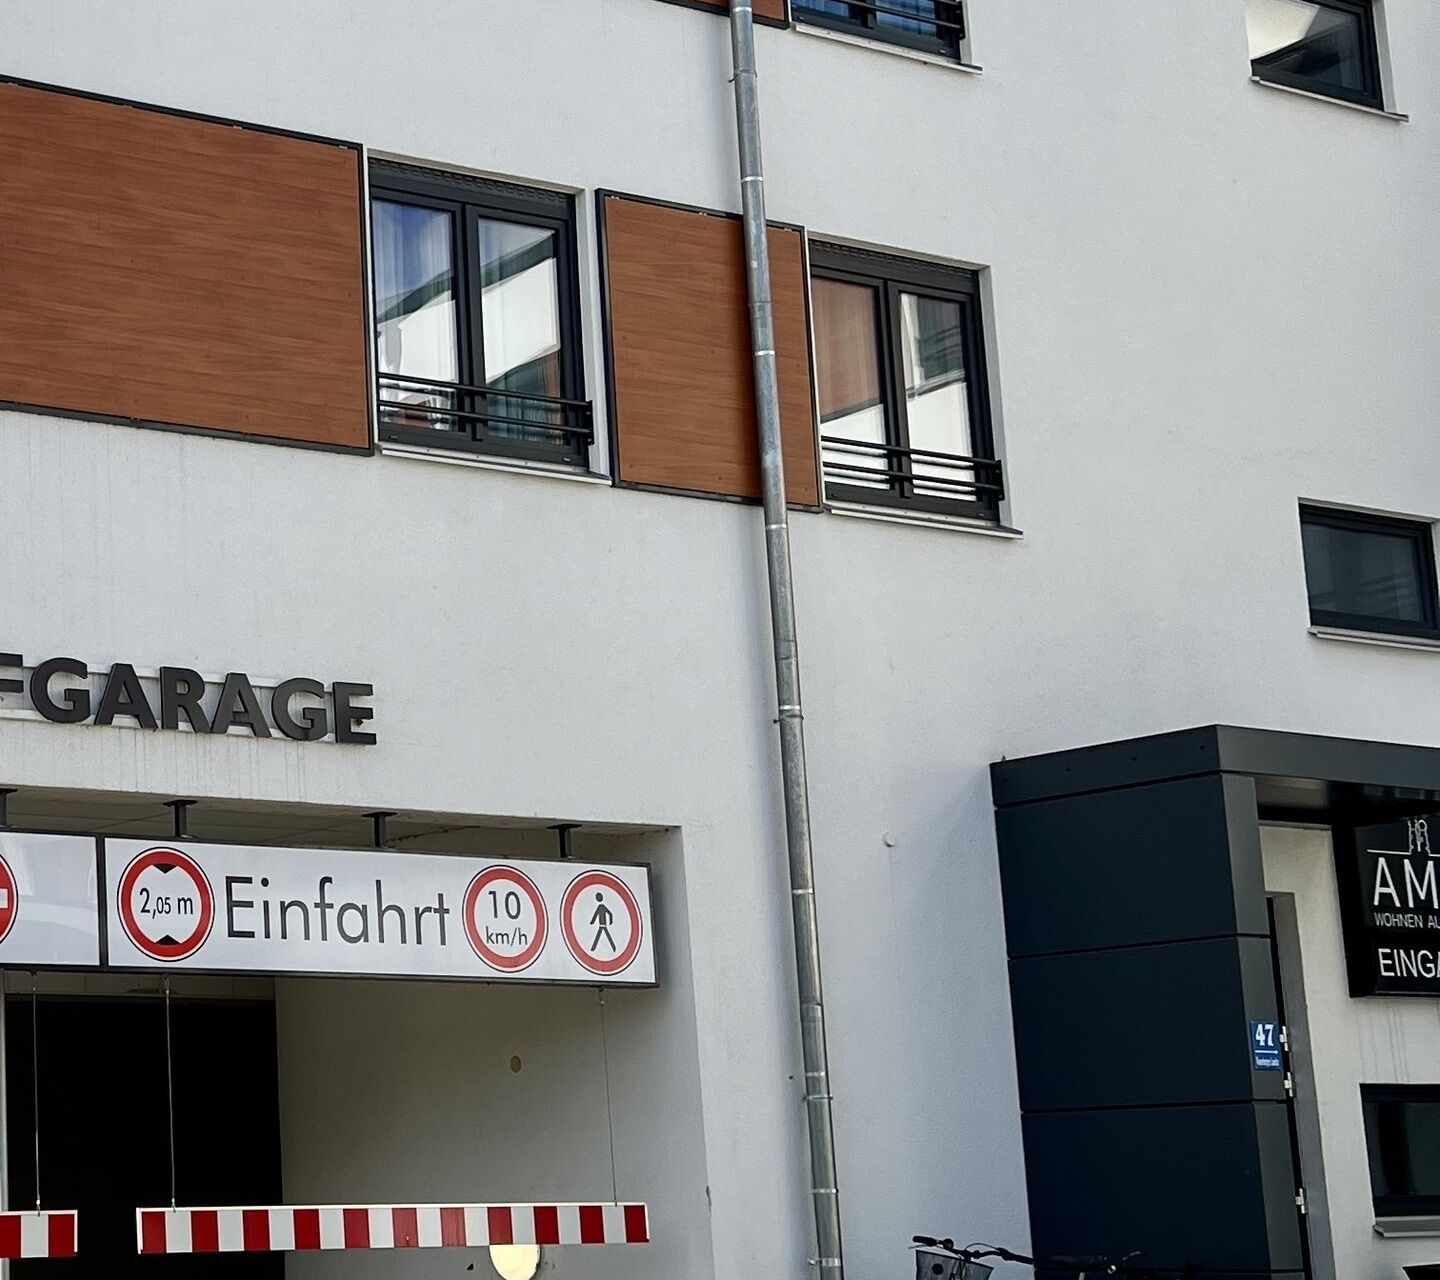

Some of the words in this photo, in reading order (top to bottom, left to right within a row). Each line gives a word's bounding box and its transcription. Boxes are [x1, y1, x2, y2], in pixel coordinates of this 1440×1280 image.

[177, 896, 194, 916] m
[224, 874, 450, 946] Einfahrt
[488, 890, 521, 920] 10
[1374, 912, 1423, 928] WOHNEN
[485, 926, 528, 948] km/h
[1255, 1023, 1274, 1047] 47
